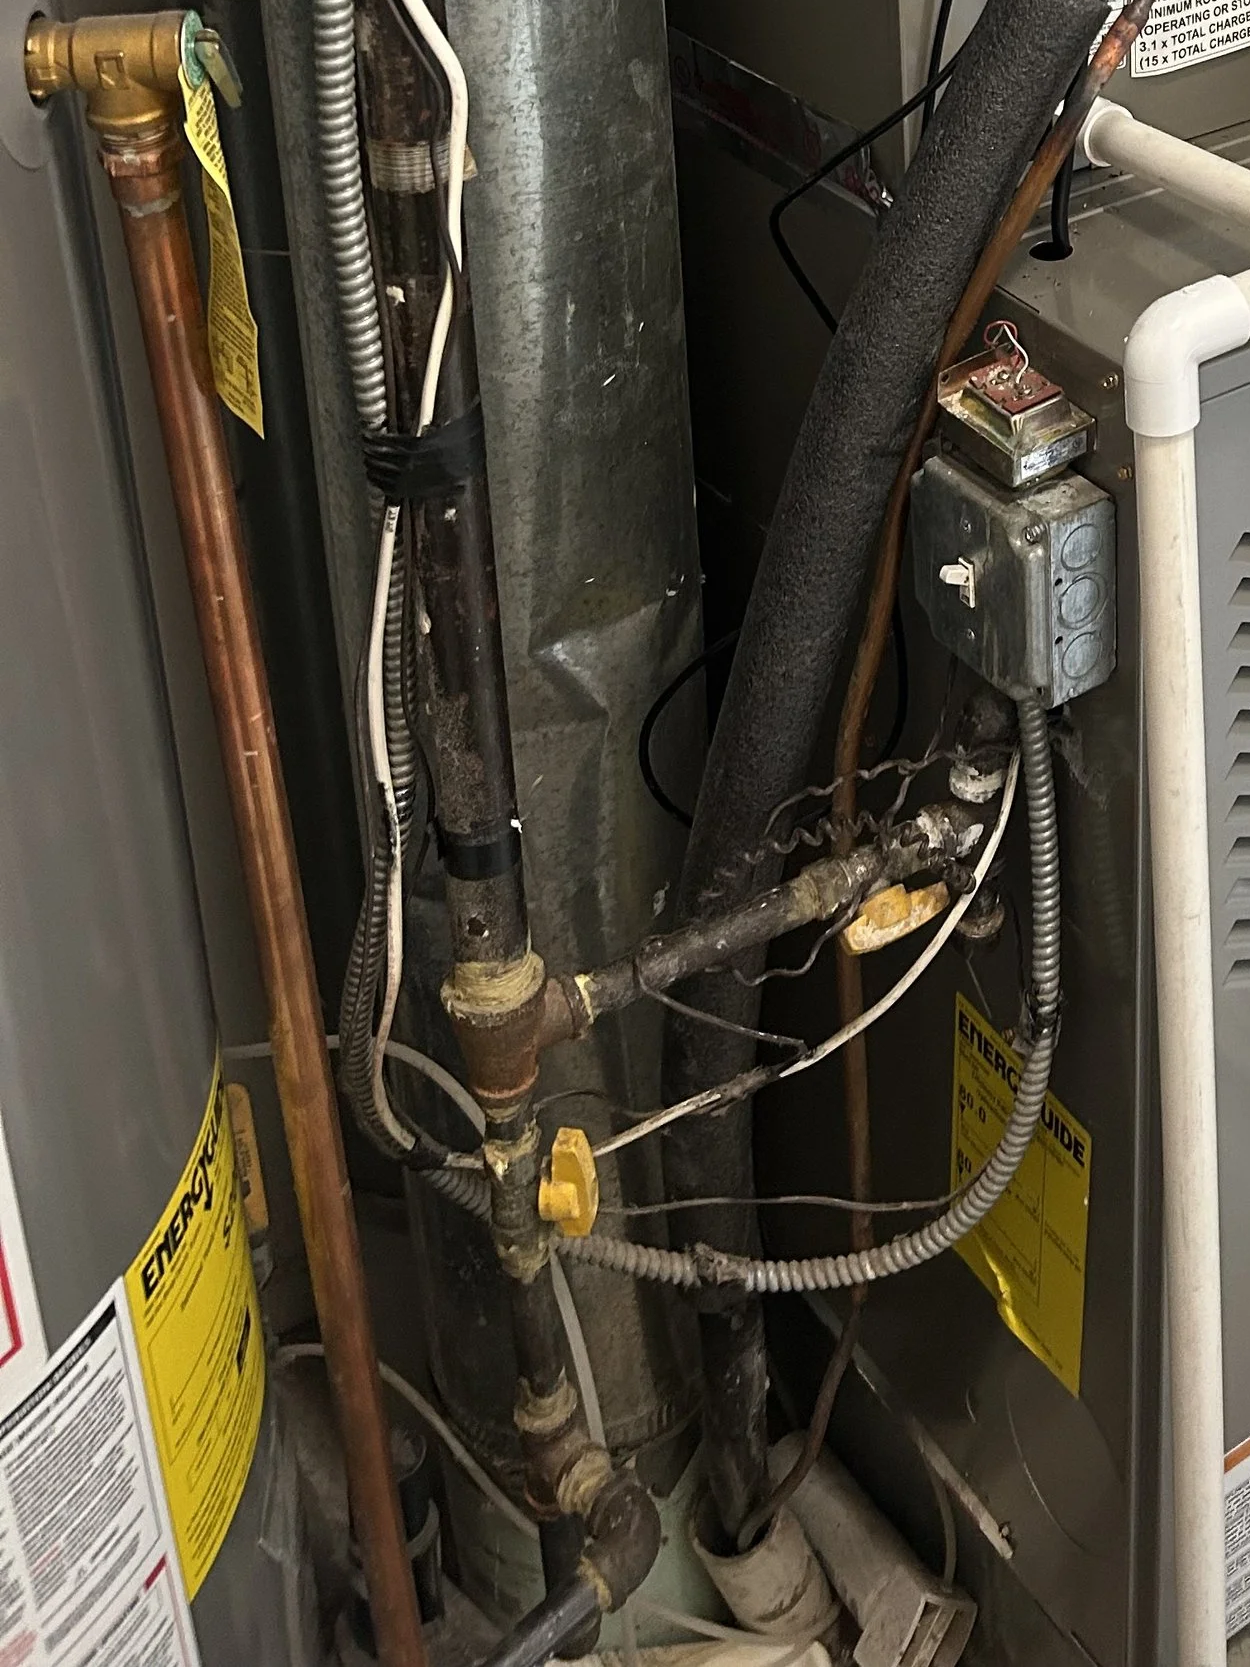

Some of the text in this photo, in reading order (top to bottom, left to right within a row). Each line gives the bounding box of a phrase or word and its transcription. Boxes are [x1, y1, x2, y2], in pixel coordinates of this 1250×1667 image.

[1213, 3, 1229, 17] OR
[1139, 40, 1157, 52] 3.1
[1161, 40, 1168, 49] x
[1171, 27, 1207, 46] TOTAL
[1139, 56, 1159, 70] (15
[1162, 54, 1169, 64] x
[1171, 42, 1207, 61] TOTAL
[958, 1010, 1086, 1168] ENERGUIDE
